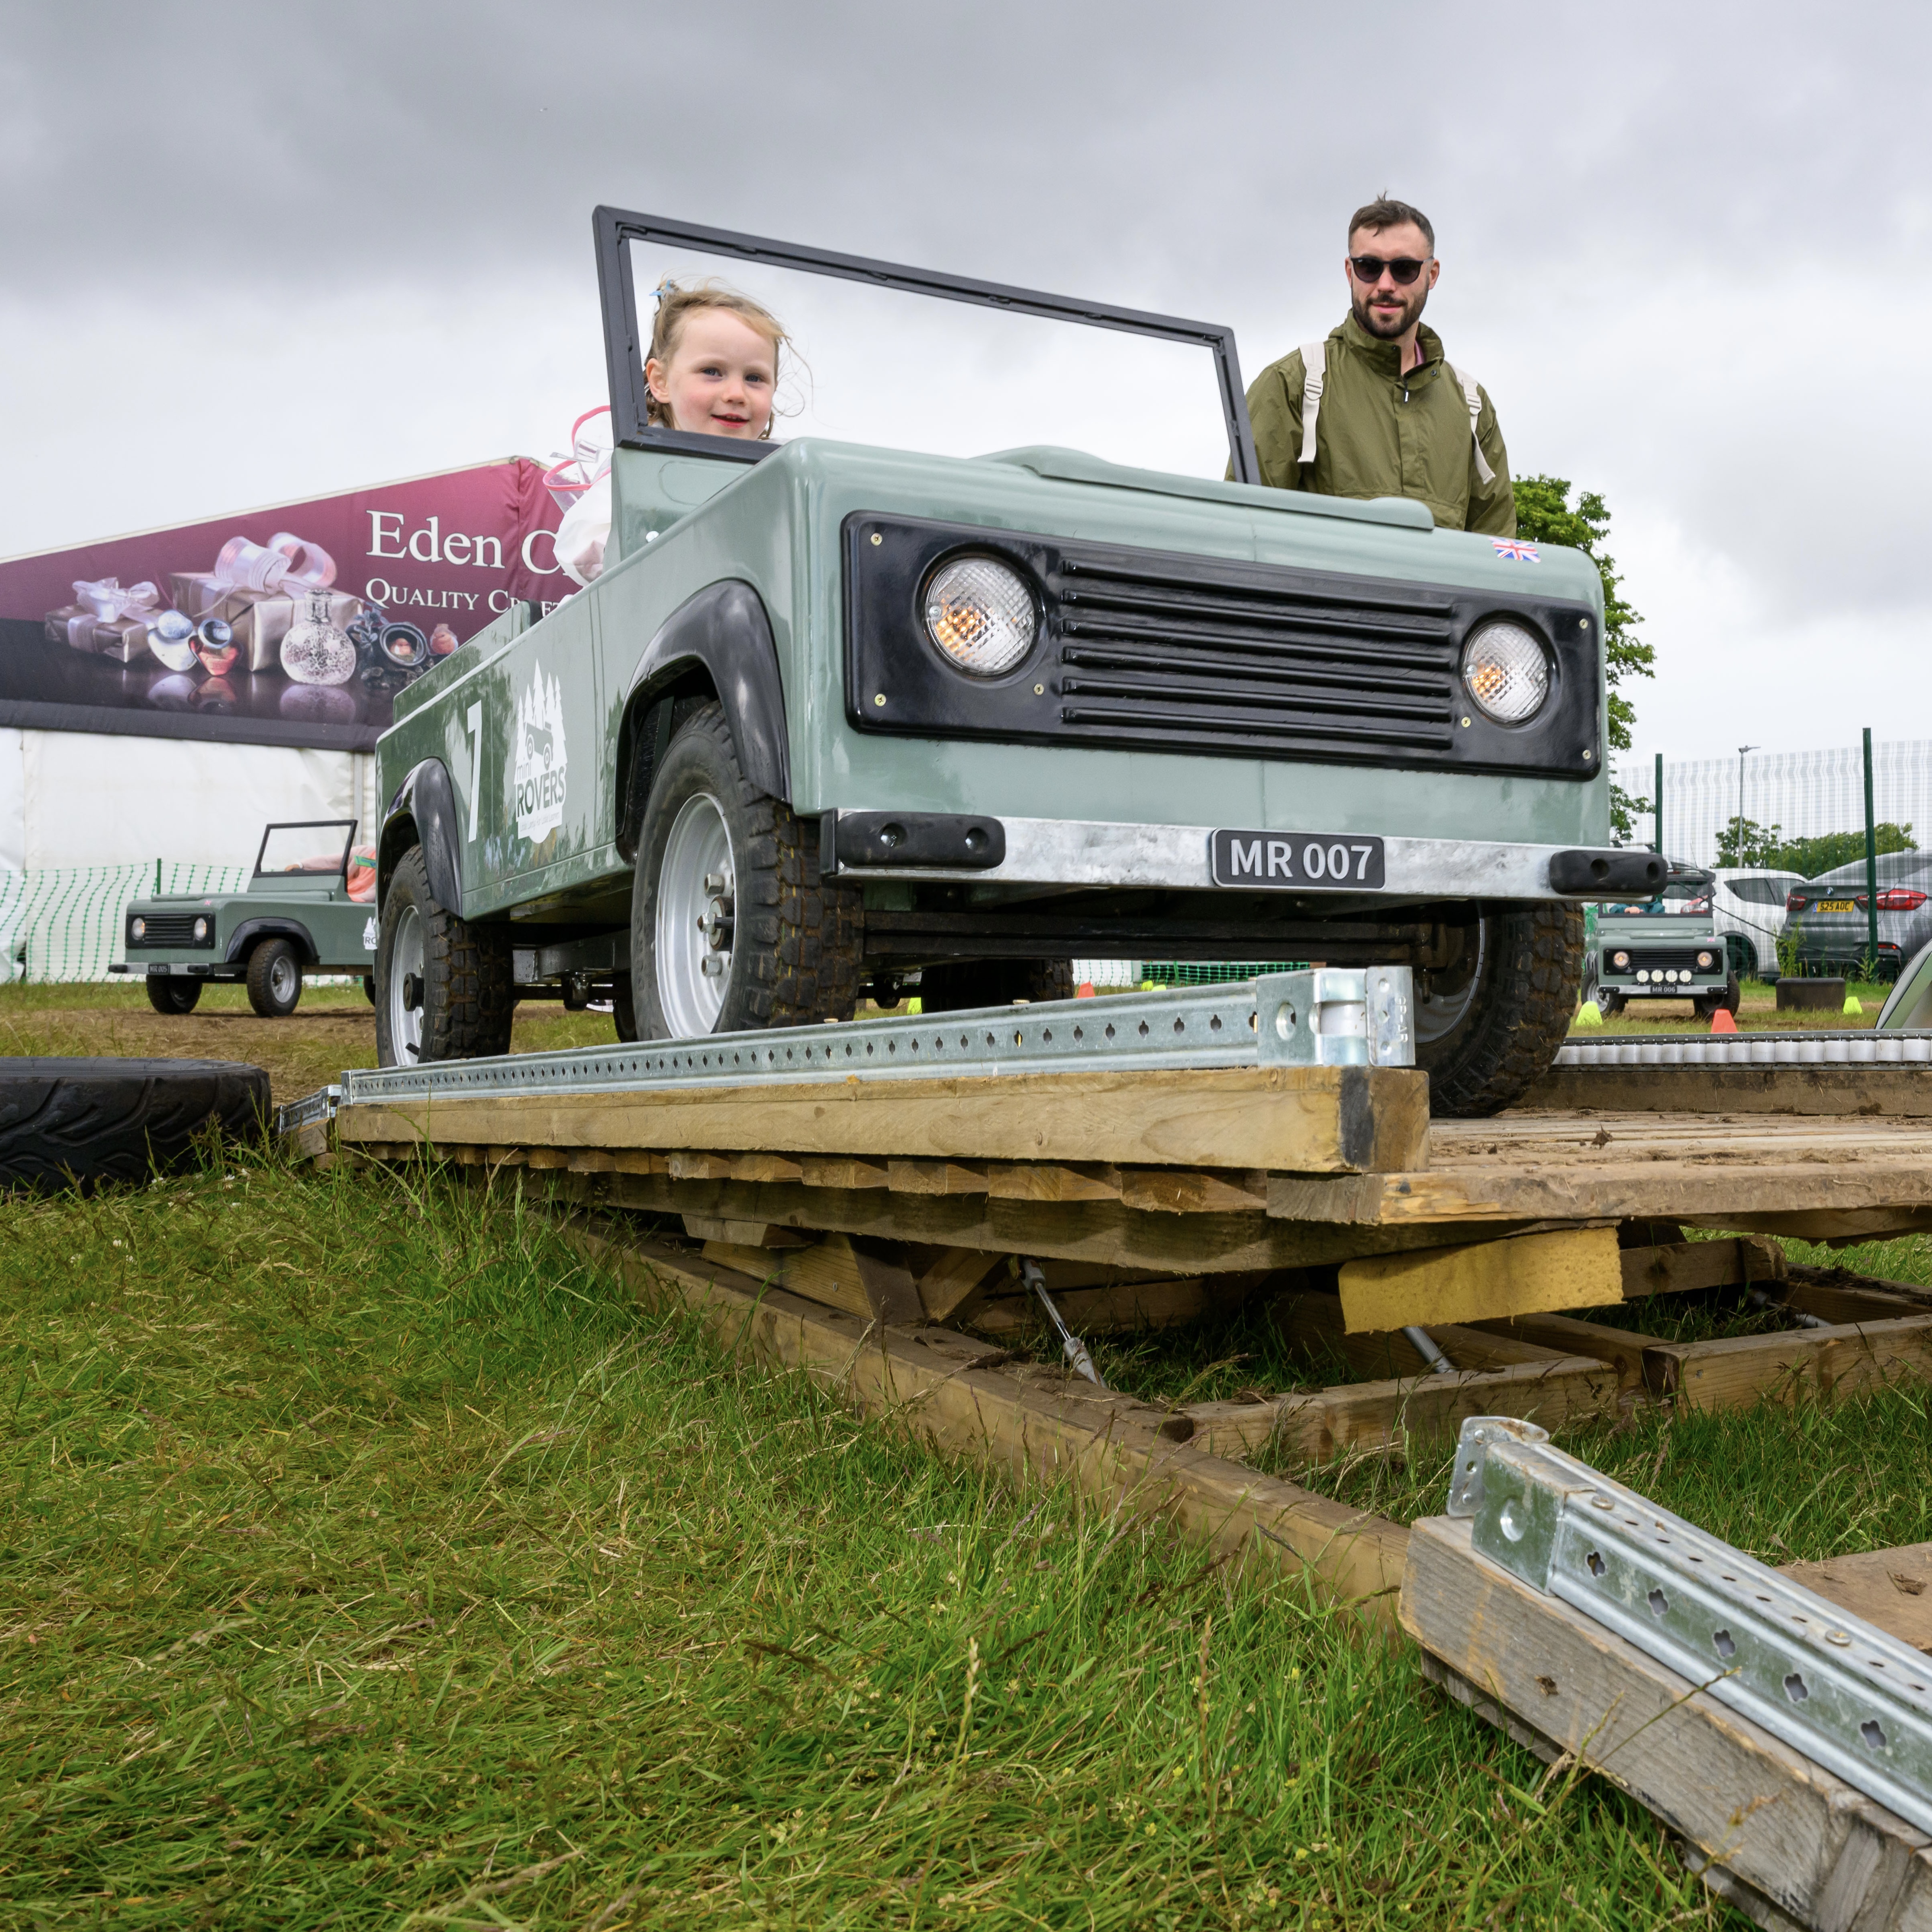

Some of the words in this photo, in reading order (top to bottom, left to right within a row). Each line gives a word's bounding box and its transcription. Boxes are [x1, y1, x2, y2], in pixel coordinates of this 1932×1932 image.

[366, 510, 505, 568] Eden
[366, 578, 479, 610] QUALITY
[467, 700, 482, 843] 7
[517, 759, 531, 781] mini
[517, 766, 564, 818] ROVERS
[1231, 839, 1293, 878] MR
[1303, 843, 1373, 880] 007
[1820, 902, 1833, 911] S25
